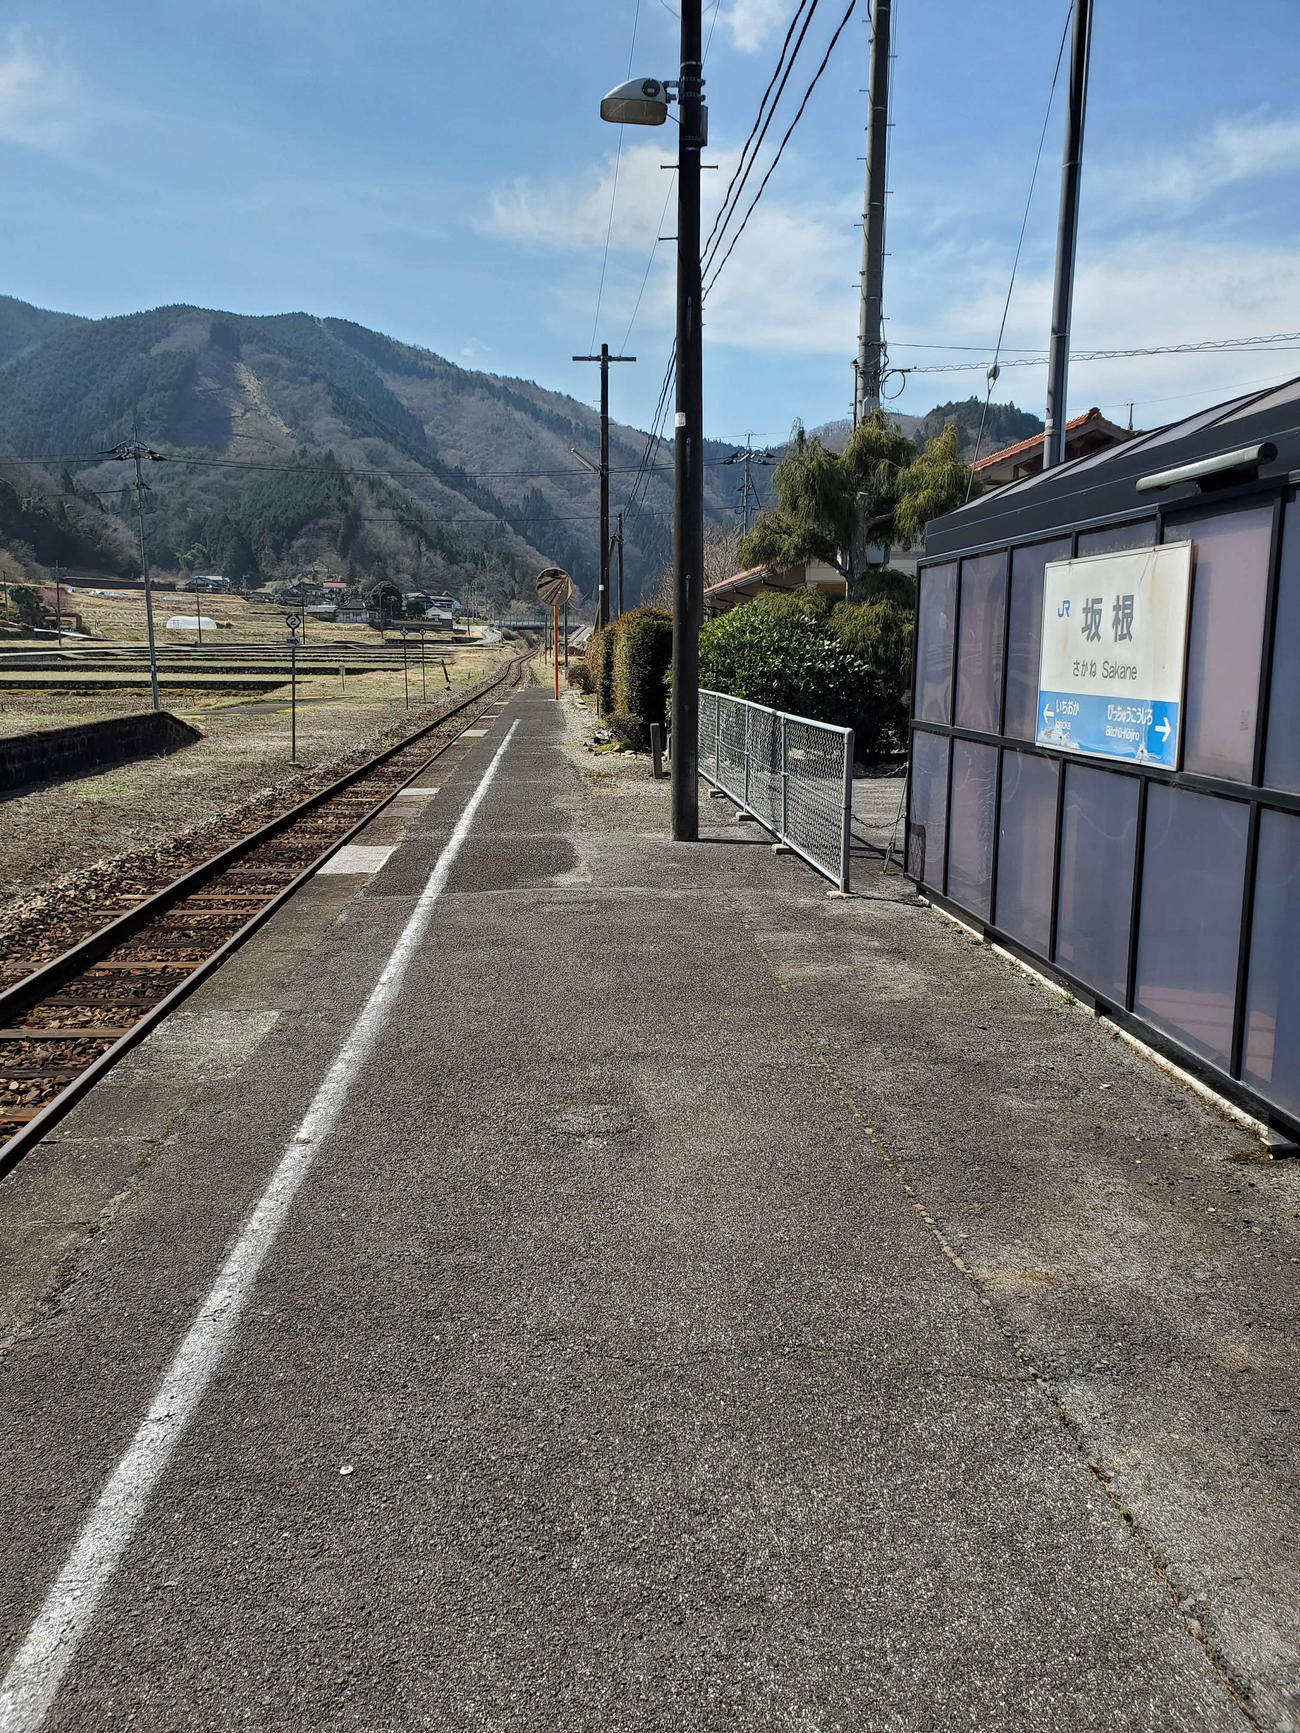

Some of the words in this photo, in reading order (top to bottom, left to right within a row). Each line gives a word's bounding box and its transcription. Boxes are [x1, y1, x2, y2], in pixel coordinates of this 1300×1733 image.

[1057, 599, 1071, 618] JR
[1081, 594, 1135, 643] 坂根
[1072, 659, 1097, 678] さかね
[1101, 660, 1138, 681] Sakane
[1055, 698, 1080, 716] いちおか
